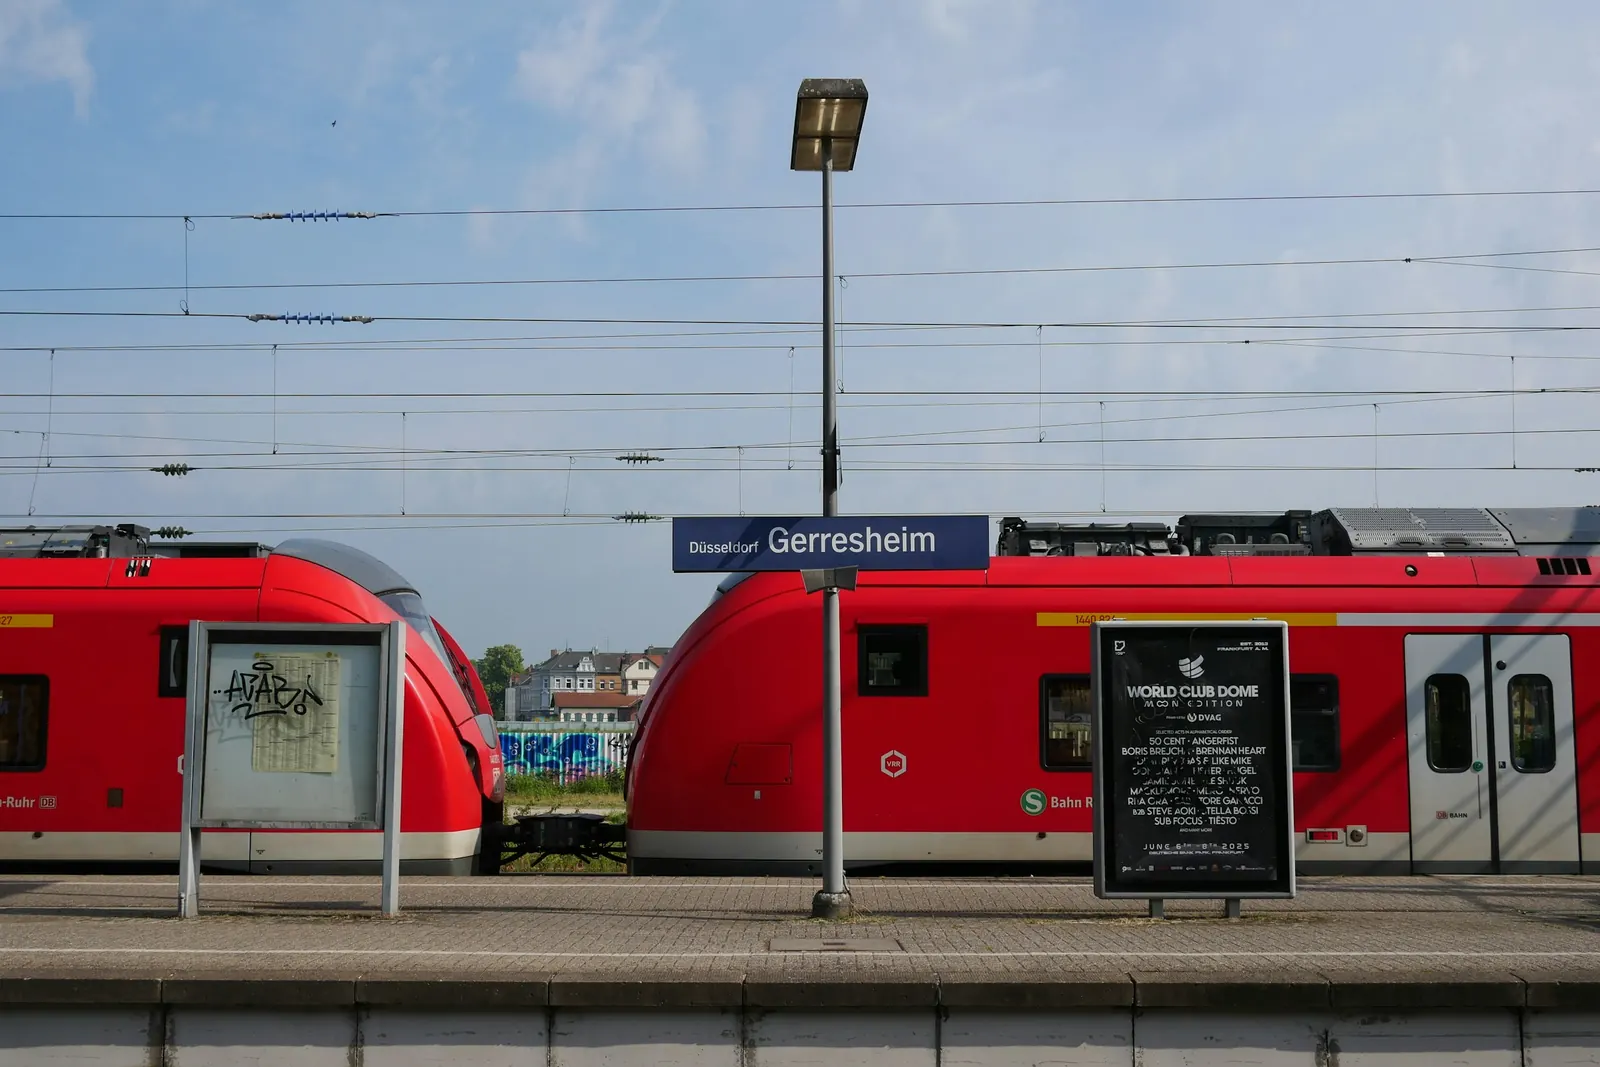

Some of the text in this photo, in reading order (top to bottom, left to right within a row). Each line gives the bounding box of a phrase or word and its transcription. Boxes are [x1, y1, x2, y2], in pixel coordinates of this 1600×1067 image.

[689, 526, 936, 554] Düsseldorf Gerresheim
[0, 616, 13, 625] 27
[1075, 615, 1096, 624] 1440
[1127, 685, 1259, 698] WORLD CLUB DOME
[1187, 700, 1243, 708] EDITION
[1198, 714, 1222, 722] DVAG
[1150, 737, 1239, 745] 50 CENT ANGERFIST
[1121, 747, 1148, 755] BORIS
[1196, 747, 1237, 755] BRENNAN
[1239, 746, 1267, 755] HEART
[1211, 757, 1230, 765] LIKE
[1231, 756, 1252, 765] MIKE
[41, 798, 55, 807] DB
[1025, 791, 1043, 813] S
[1051, 796, 1082, 808] Bahn
[1146, 807, 1173, 815] STEVE
[1174, 807, 1196, 815] AOKI
[1154, 816, 1238, 825] SUB FOCUS TIËSTO
